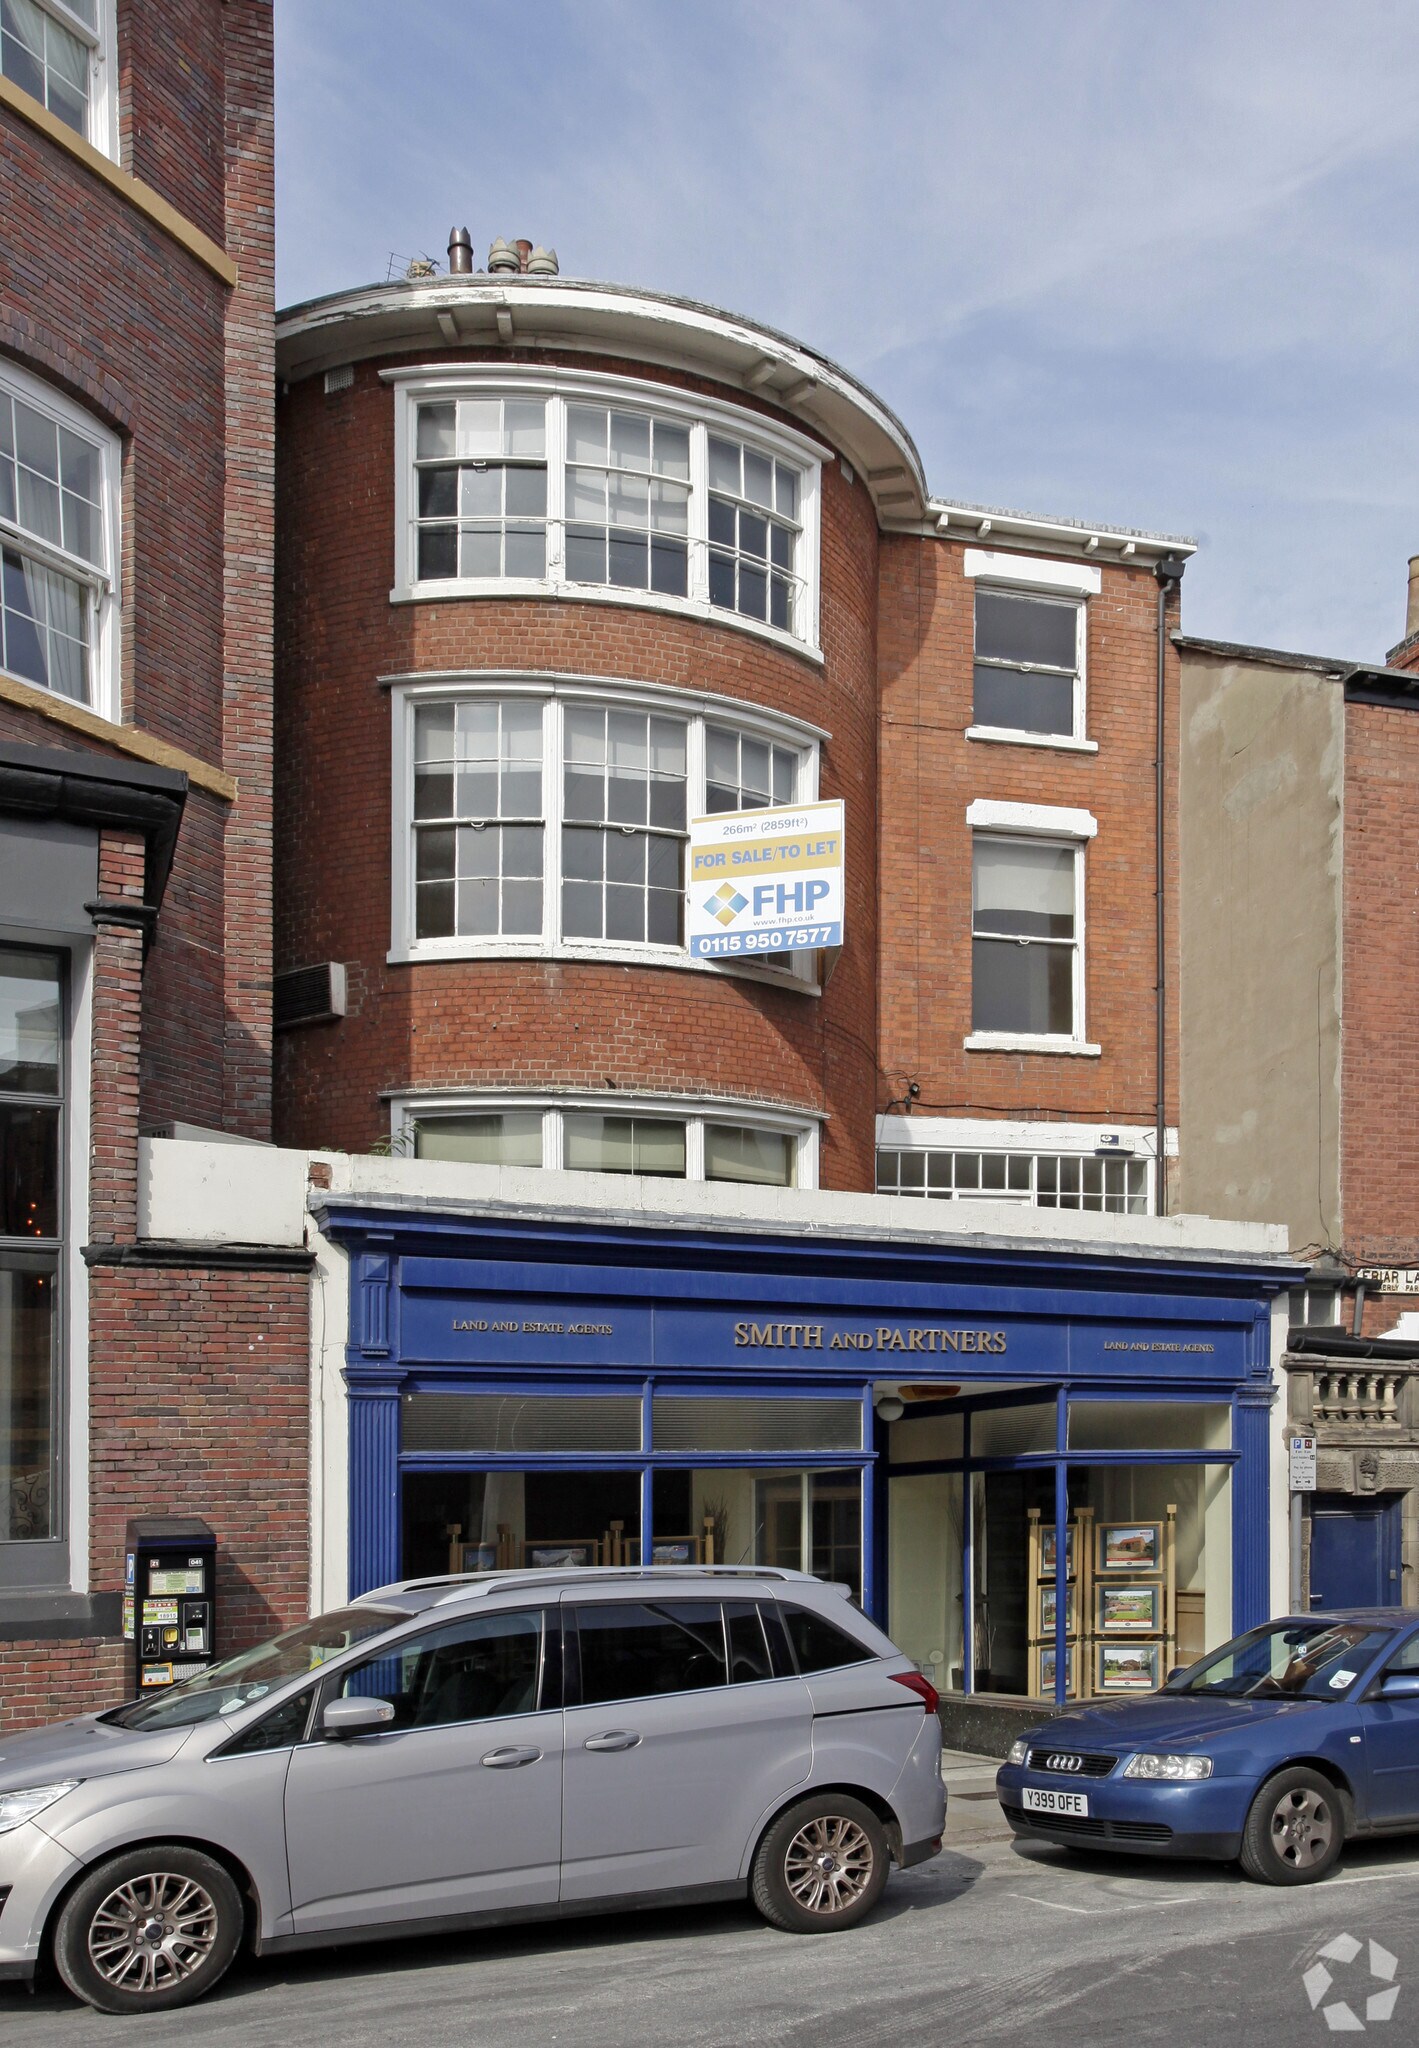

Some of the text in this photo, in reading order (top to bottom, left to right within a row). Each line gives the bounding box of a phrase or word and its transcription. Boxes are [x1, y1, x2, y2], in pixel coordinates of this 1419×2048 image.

[694, 840, 837, 869] FOR SALE/TO LET
[753, 880, 830, 916] FHP
[753, 914, 815, 926] www.fhp.co.uk
[699, 927, 832, 953] 0115 950 7577
[1362, 1270, 1399, 1284] FRIAR
[452, 1320, 613, 1335] LAND AND ESTATE AGENTS
[734, 1322, 1007, 1353] SMITH AND PARTNERS
[1104, 1341, 1215, 1353] LAND AND ESTATE AGENTS
[1027, 1790, 1082, 1812] Y399 OFE
